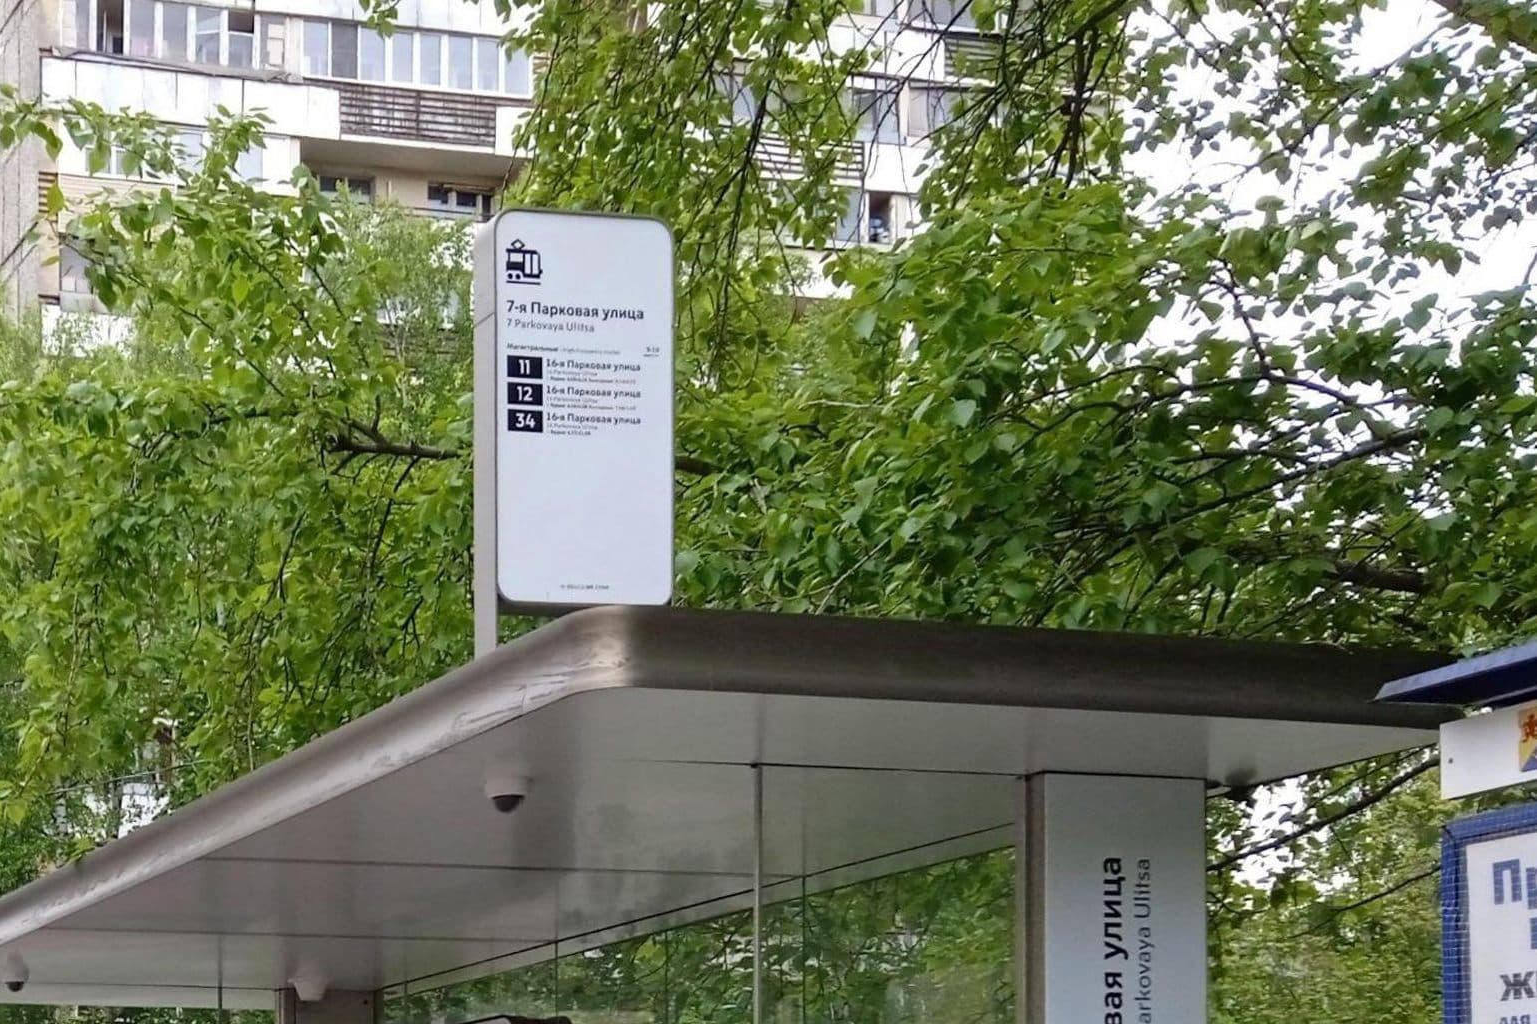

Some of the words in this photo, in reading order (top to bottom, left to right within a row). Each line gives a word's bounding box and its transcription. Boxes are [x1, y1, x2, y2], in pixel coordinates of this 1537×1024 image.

[506, 299, 527, 314] 7-я
[531, 301, 599, 318] Парковая
[602, 308, 645, 321] улица
[506, 317, 513, 328] 7
[514, 320, 564, 333] Parkovaya
[566, 322, 595, 334] Ulitsa
[518, 359, 531, 375] 11
[567, 360, 611, 371] Парковая
[613, 362, 641, 372] улица
[516, 386, 534, 402] 12
[567, 386, 612, 398] Парковая
[613, 389, 641, 399] улица
[515, 412, 536, 429] 34
[567, 413, 612, 425] Парковая
[613, 416, 641, 426] улица
[1132, 858, 1153, 919] Ulitsa
[1102, 857, 1129, 961] улица
